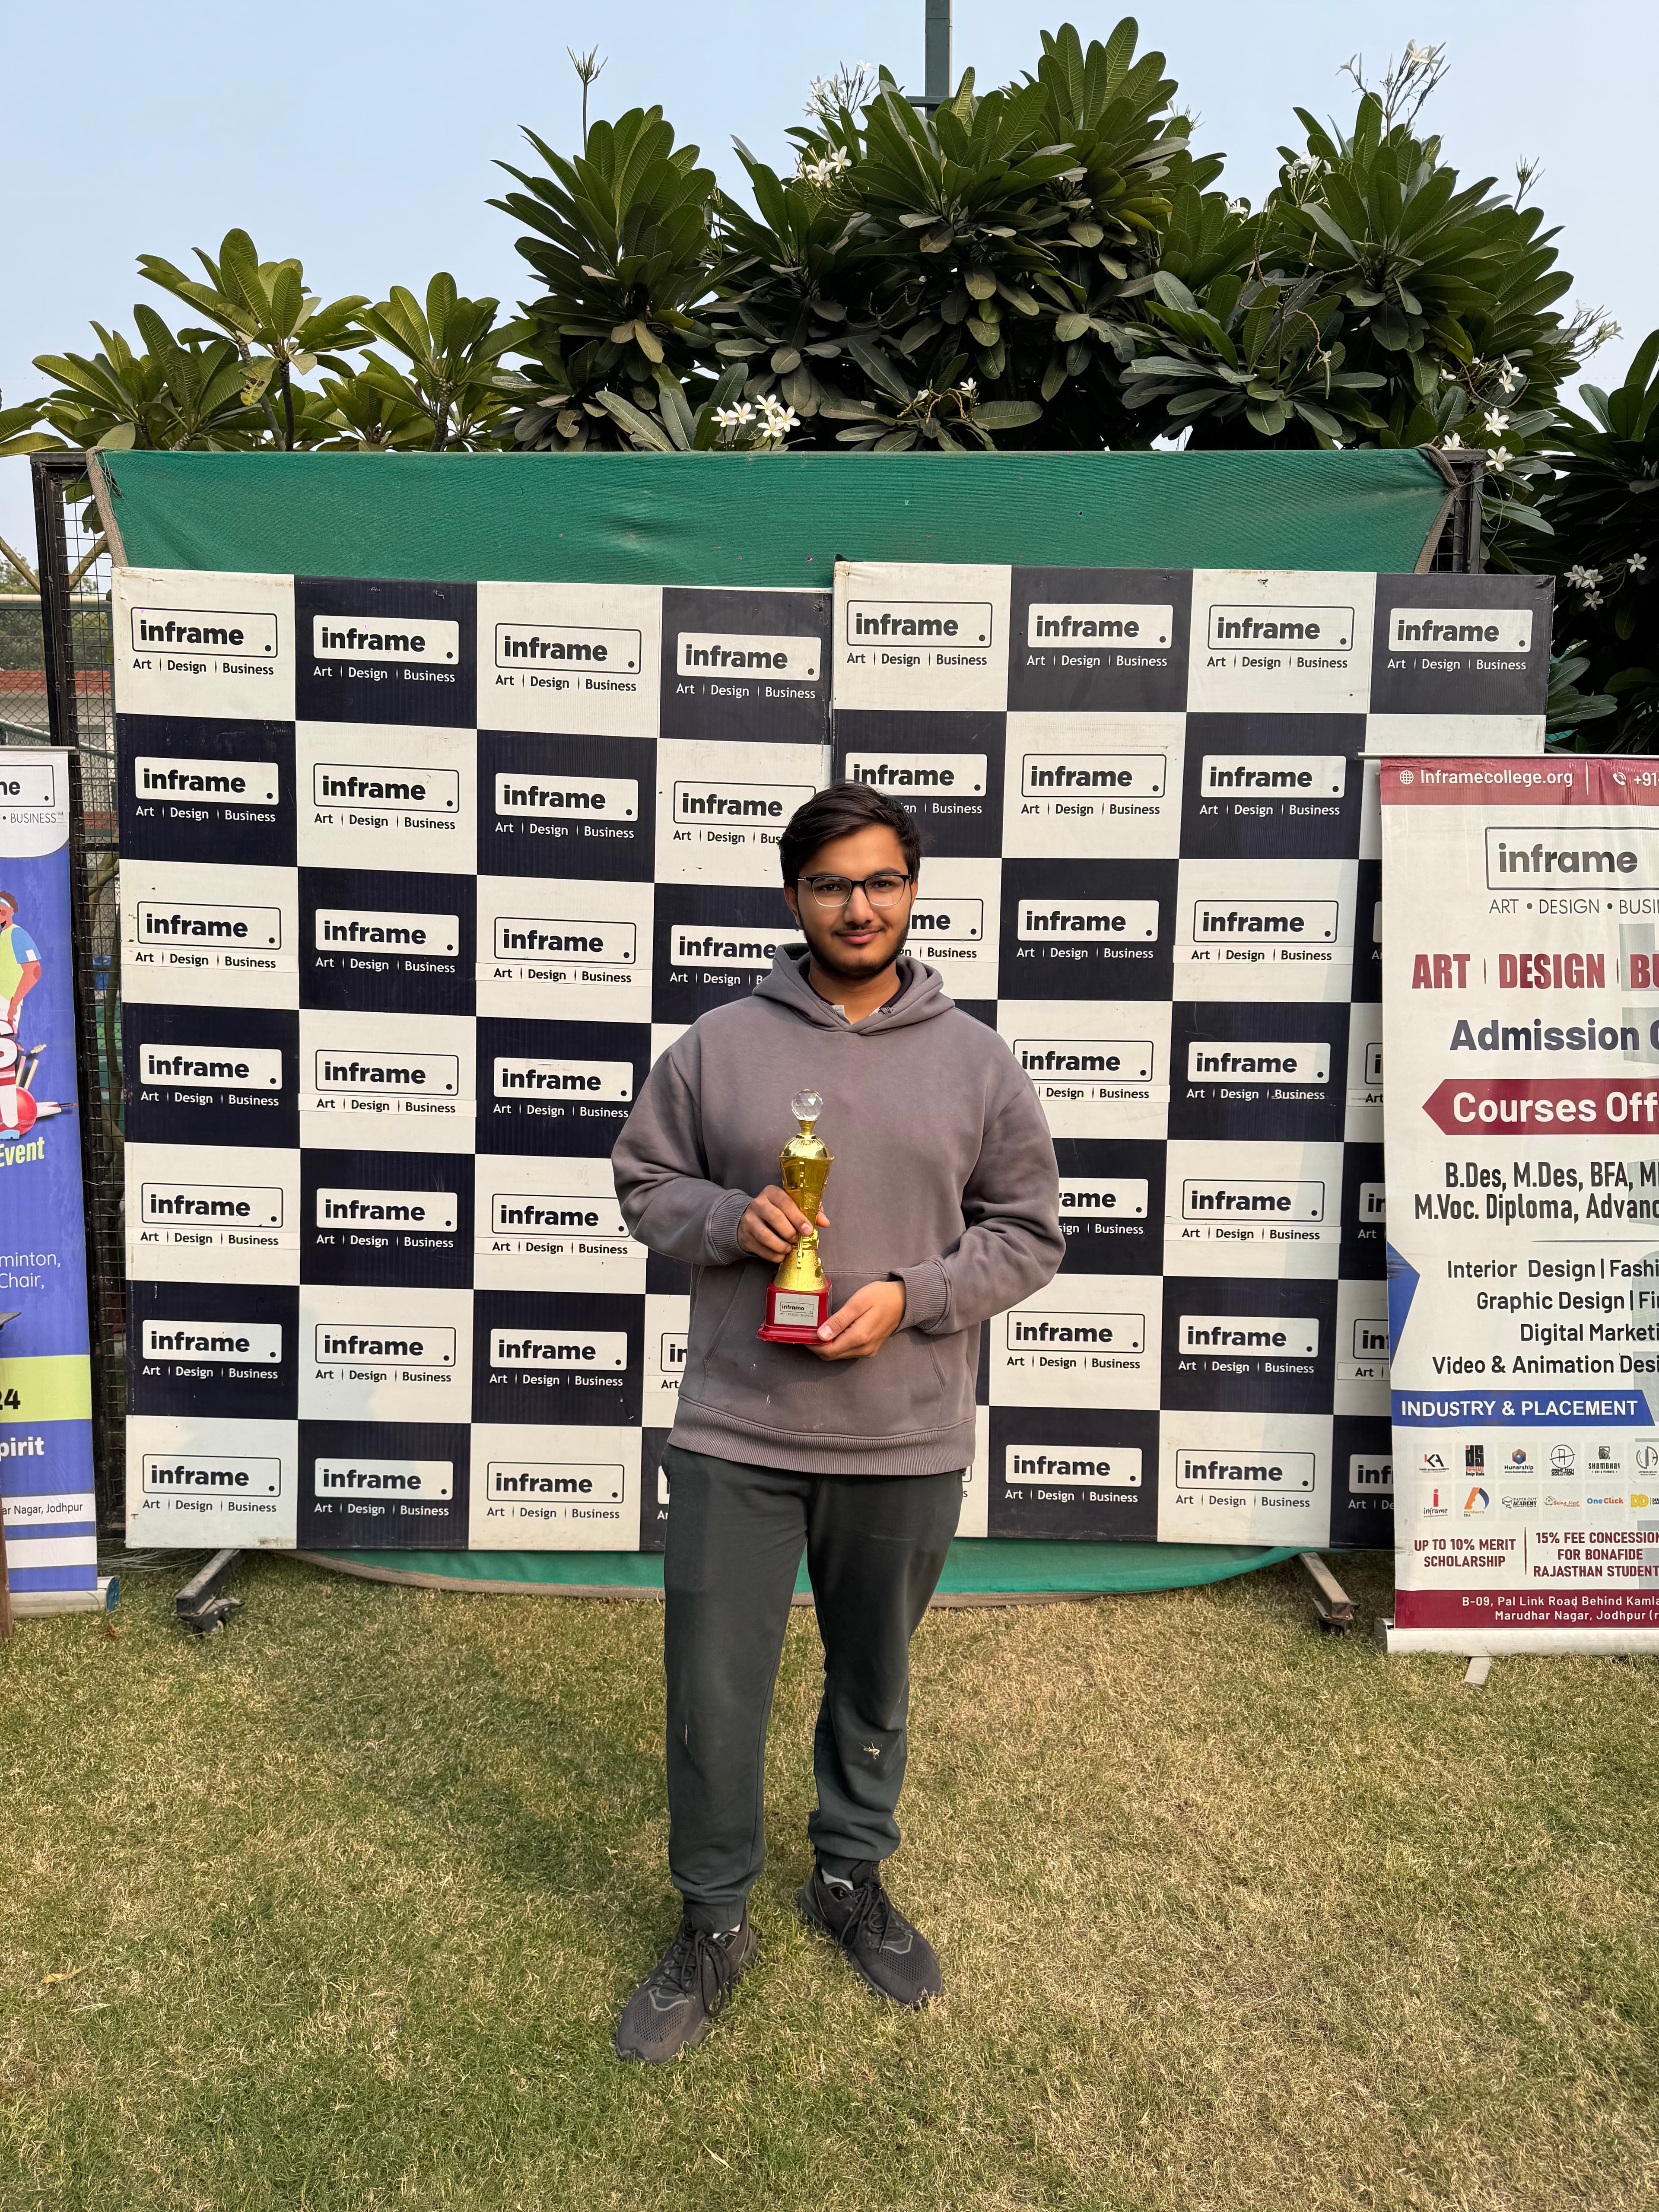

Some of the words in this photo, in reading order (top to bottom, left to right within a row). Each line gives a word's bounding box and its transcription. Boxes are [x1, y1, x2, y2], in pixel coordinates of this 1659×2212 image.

[140, 619, 245, 646] inframe
[1036, 615, 1140, 638] inframe
[1397, 619, 1500, 642] inframe
[685, 643, 788, 670] inframe
[1026, 654, 1046, 666] Art
[1061, 655, 1101, 669] Design
[1116, 655, 1168, 667] Business
[1387, 658, 1407, 669] Art
[1421, 658, 1461, 672] Design
[1476, 658, 1527, 671] Business
[132, 658, 153, 670] Art
[167, 659, 207, 675] Design
[222, 662, 274, 676] Business
[676, 683, 696, 695] Art
[710, 684, 750, 699] Design
[765, 686, 816, 699] Business
[1030, 765, 1133, 787] inframe
[1421, 768, 1573, 788] Inframecollege.org
[322, 775, 426, 801] inframe
[503, 784, 606, 810] inframe
[10, 812, 57, 824] BUSINESS
[1020, 803, 1040, 814] Art
[1055, 803, 1094, 817] Design
[1109, 803, 1160, 815] Business
[314, 812, 334, 824] Art
[349, 814, 389, 829] Design
[404, 816, 456, 830] Business
[495, 821, 514, 833] Art
[529, 823, 569, 838] Design
[584, 825, 635, 839] Business
[1498, 842, 1638, 874] inframe
[1489, 898, 1519, 915] ART
[1538, 898, 1600, 915] DESIGN
[1619, 898, 1659, 915] BUSI
[146, 912, 248, 938] inframe
[1202, 911, 1305, 933] inframe
[135, 951, 155, 963] Art
[169, 953, 209, 967] Design
[225, 955, 276, 969] Business
[1191, 949, 1211, 960] Art
[1226, 949, 1265, 963] Design
[1281, 950, 1332, 961] Business
[1411, 953, 1471, 990] ART
[1497, 953, 1606, 990] DESIGN
[1449, 1016, 1640, 1052] Admission
[324, 1061, 426, 1085] inframe
[1046, 1087, 1084, 1100] Design
[1099, 1087, 1150, 1099] Business
[316, 1098, 336, 1109] Art
[351, 1099, 390, 1113] Design
[405, 1101, 456, 1113] Business
[1452, 1090, 1597, 1123] Courses
[1605, 1090, 1659, 1123] Off
[1445, 1161, 1506, 1193] B.Des,
[1513, 1161, 1584, 1193] M.Des,
[1589, 1160, 1634, 1193] BFA,
[325, 1198, 426, 1221] inframe
[500, 1204, 599, 1227] inframe
[1414, 1193, 1480, 1220] M.Voc.
[1485, 1192, 1580, 1226] Diploma,
[315, 1233, 335, 1245] Art
[350, 1234, 389, 1249] Design
[404, 1236, 454, 1248] Business
[492, 1241, 511, 1252] Art
[525, 1242, 564, 1255] Design
[578, 1243, 628, 1255] Business
[1446, 1259, 1518, 1278] Interior
[1528, 1258, 1596, 1282] Design
[1476, 1290, 1554, 1314] Graphic
[1557, 1290, 1625, 1314] Design
[1638, 1289, 1659, 1310] Fi
[1187, 1325, 1287, 1348] inframe
[1519, 1322, 1584, 1346] Digital
[1178, 1360, 1197, 1371] Art
[1211, 1360, 1250, 1374] Design
[1265, 1362, 1315, 1374] Business
[1431, 1355, 1486, 1375] Video
[1491, 1355, 1507, 1375] &
[1511, 1354, 1615, 1375] Animation
[1400, 1400, 1497, 1419] INDUSTRY
[1501, 1400, 1516, 1417] &
[1521, 1399, 1639, 1417] PLACEMENT
[1014, 1455, 1111, 1477] inframe
[496, 1472, 593, 1494] inframe
[1004, 1489, 1023, 1500] Art
[1037, 1489, 1075, 1503] Design
[1089, 1491, 1138, 1503] Business
[13, 1504, 44, 1516] Nagar,
[45, 1501, 83, 1514] Jodhpur
[486, 1506, 505, 1517] Art
[519, 1507, 557, 1520] Design
[572, 1508, 620, 1519] Business
[1414, 1539, 1429, 1552] UP
[1432, 1538, 1446, 1551] TO
[1449, 1538, 1475, 1551] 10%
[1478, 1538, 1516, 1551] MERIT
[1535, 1532, 1560, 1545] 15%
[1564, 1532, 1586, 1544] FEE
[1423, 1554, 1506, 1568] SCHOLARSHIP
[1557, 1548, 1581, 1561] FOR
[1585, 1548, 1644, 1560] BONAFIDE
[1532, 1565, 1604, 1578] RAJASTHAN
[1462, 1595, 1494, 1608] B-09,
[1497, 1595, 1516, 1607] Pal
[1519, 1595, 1545, 1607] Link
[1548, 1595, 1578, 1607] Road
[1581, 1595, 1623, 1606] Behind
[1494, 1610, 1551, 1622] Marudhar
[1554, 1610, 1593, 1623] Nagar,
[1595, 1609, 1646, 1623] Jodhpur
